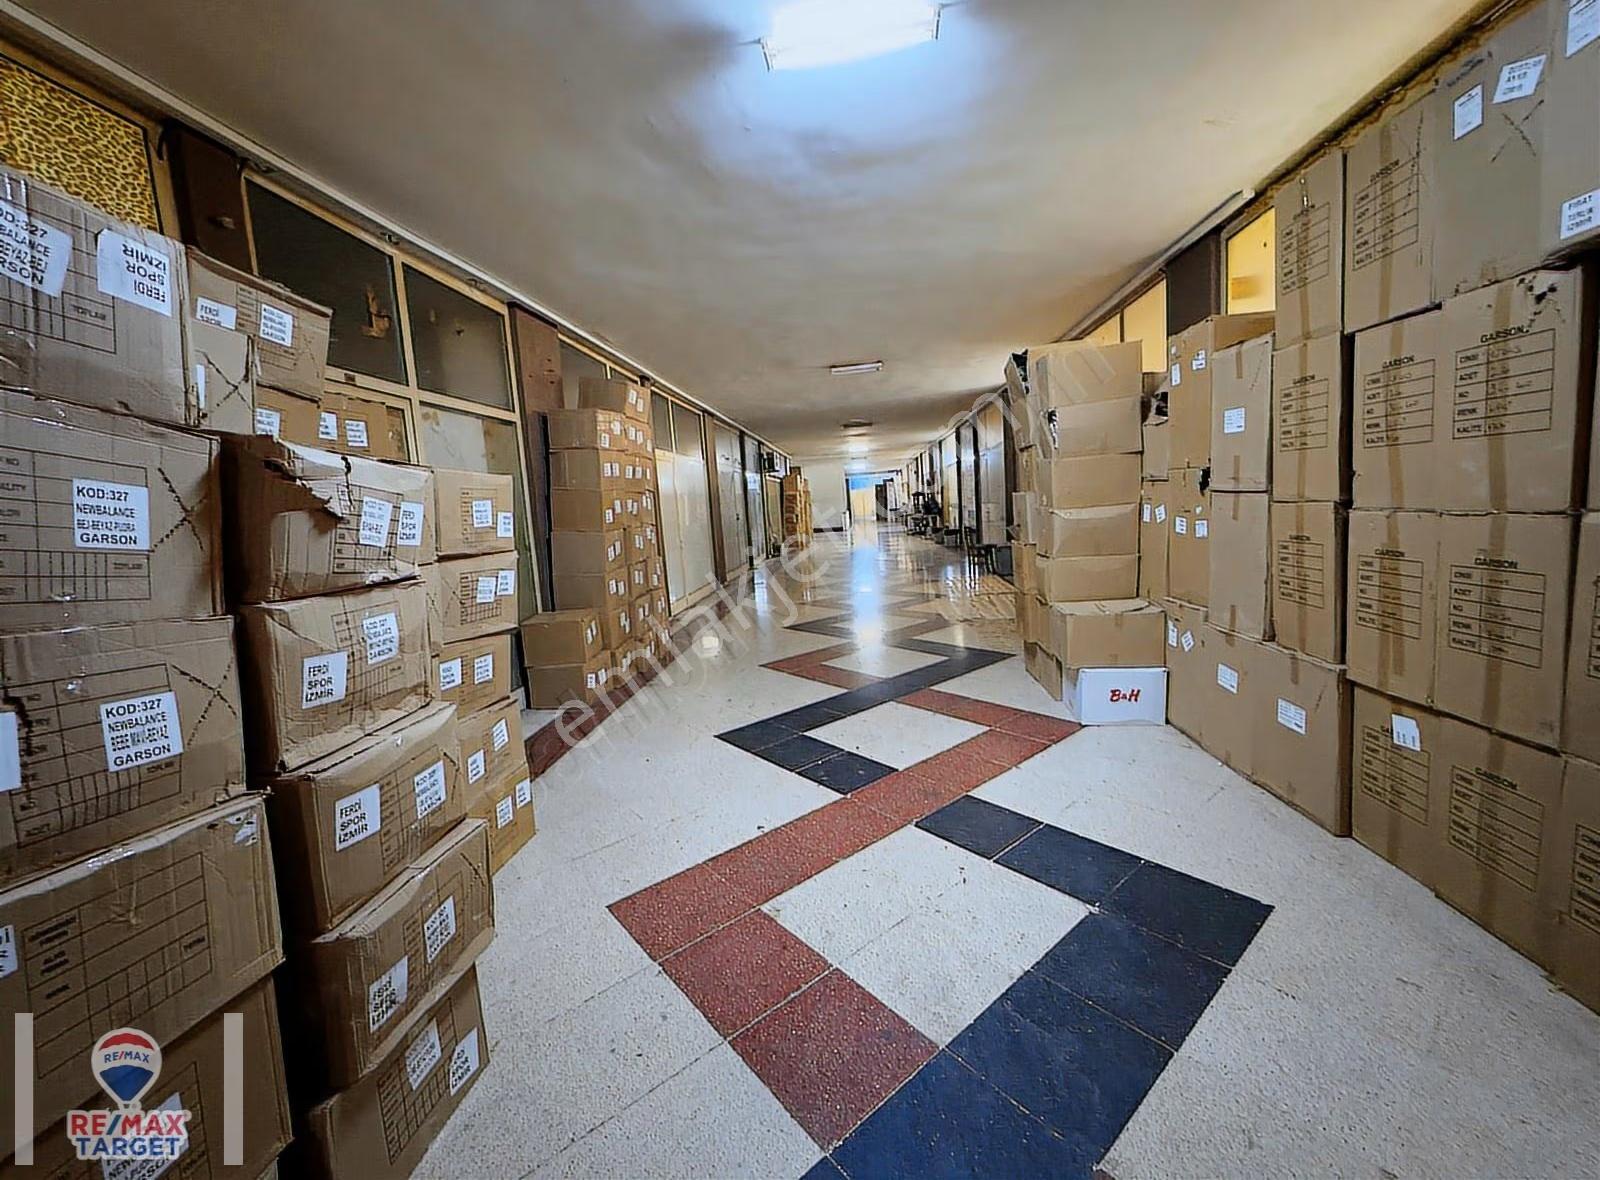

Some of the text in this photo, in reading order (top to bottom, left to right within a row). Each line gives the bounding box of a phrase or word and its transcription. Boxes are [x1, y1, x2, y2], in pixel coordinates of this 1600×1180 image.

[125, 260, 165, 286] SPOR
[76, 486, 129, 502] KOD:327
[76, 503, 136, 518] NEWBALANCE
[80, 533, 138, 545] GARSON
[105, 698, 162, 719] KOD:327
[107, 711, 168, 733] NEWBALANCE
[113, 743, 171, 767] GARSON
